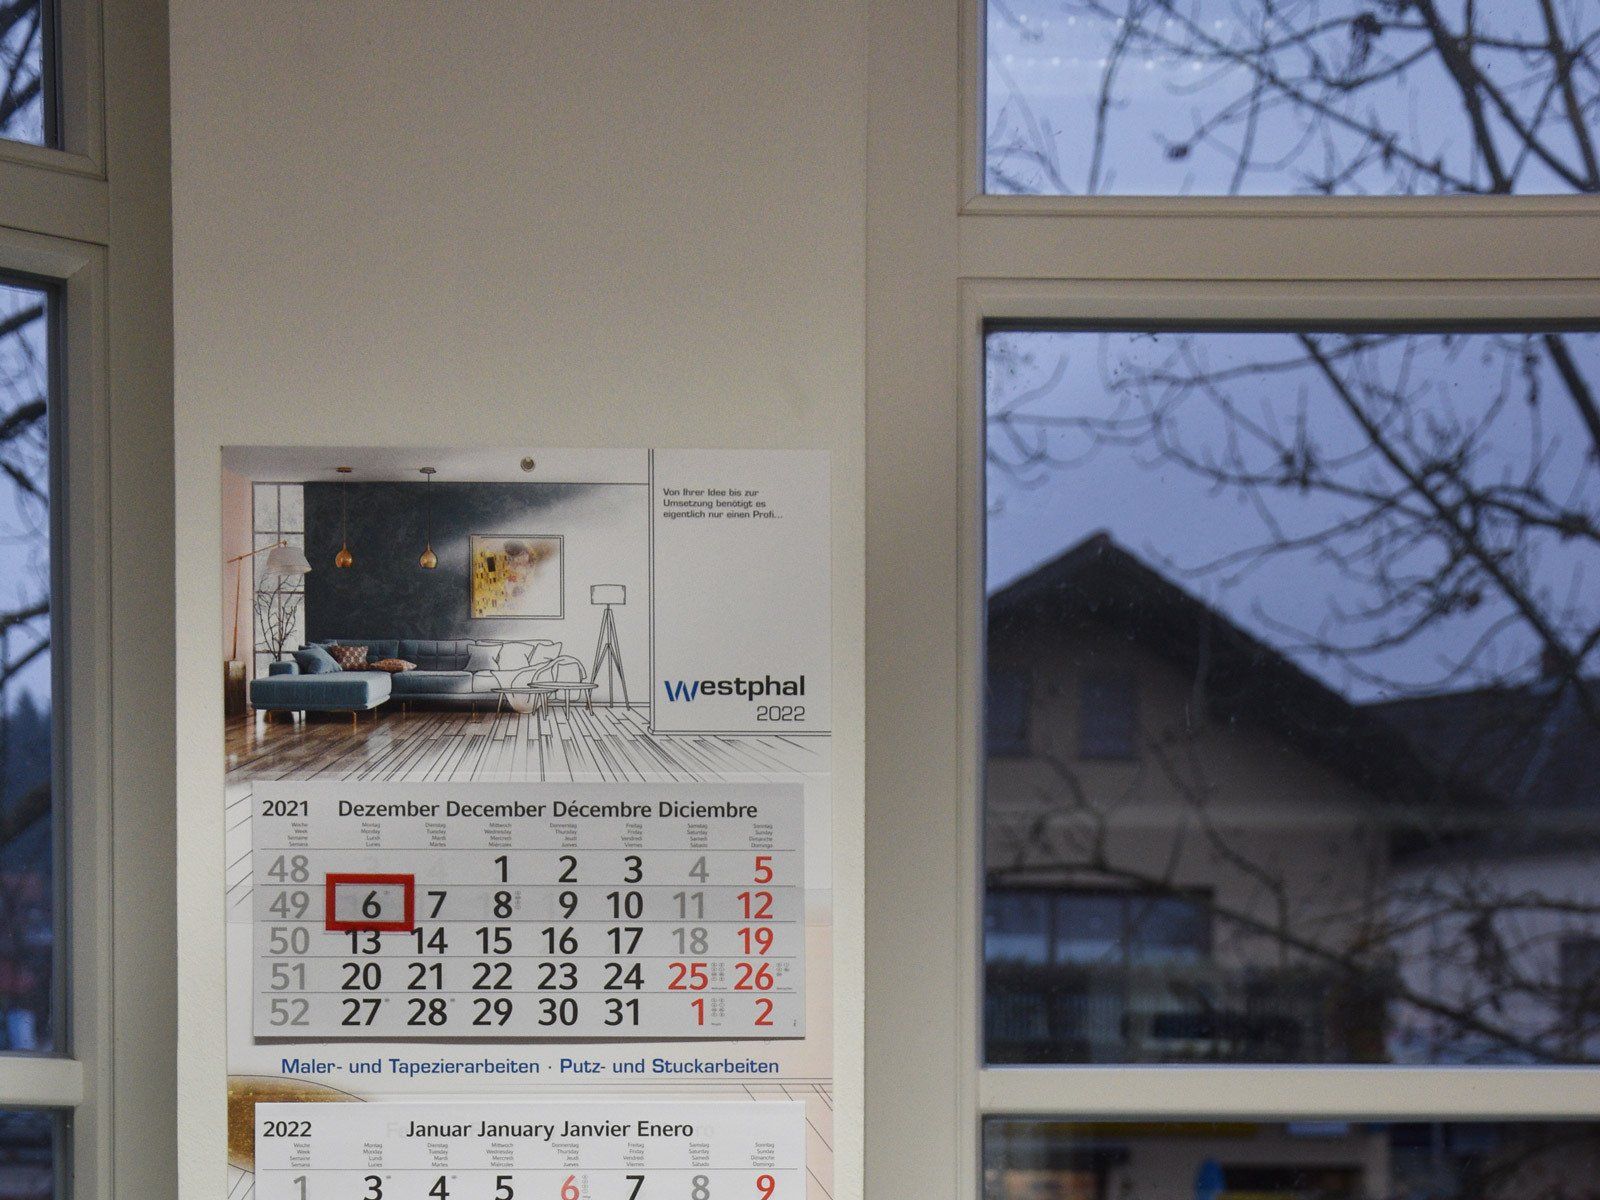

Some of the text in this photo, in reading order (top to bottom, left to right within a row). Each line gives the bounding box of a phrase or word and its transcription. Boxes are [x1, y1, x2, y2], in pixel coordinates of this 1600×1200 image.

[662, 487, 681, 497] Von
[682, 487, 705, 497] Ihrer
[707, 488, 727, 497] Idee
[728, 488, 742, 497] bis
[663, 498, 714, 510] Umsetzung
[715, 499, 753, 510] benötigt
[662, 509, 706, 520] eigentlich
[726, 511, 750, 519] einen
[752, 509, 782, 519] Profi...
[664, 675, 804, 701] Westphal
[757, 706, 805, 721] 2022
[263, 800, 757, 818] 2021 Dezember December Décembre Diciembre
[268, 855, 773, 883] 48 1 2 3 4 5
[269, 891, 772, 919] 49 6 7 8 9 10 11 12
[270, 926, 773, 955] 50 13 14 15 16 17 18 19
[270, 998, 773, 1026] 52 27 28 29 30 31 1 2
[281, 1059, 778, 1077] Maler- und Tapezierarbeiten Putz- und Stuckarbeiten
[263, 1120, 693, 1141] 2022 Januar January Janvier Enero
